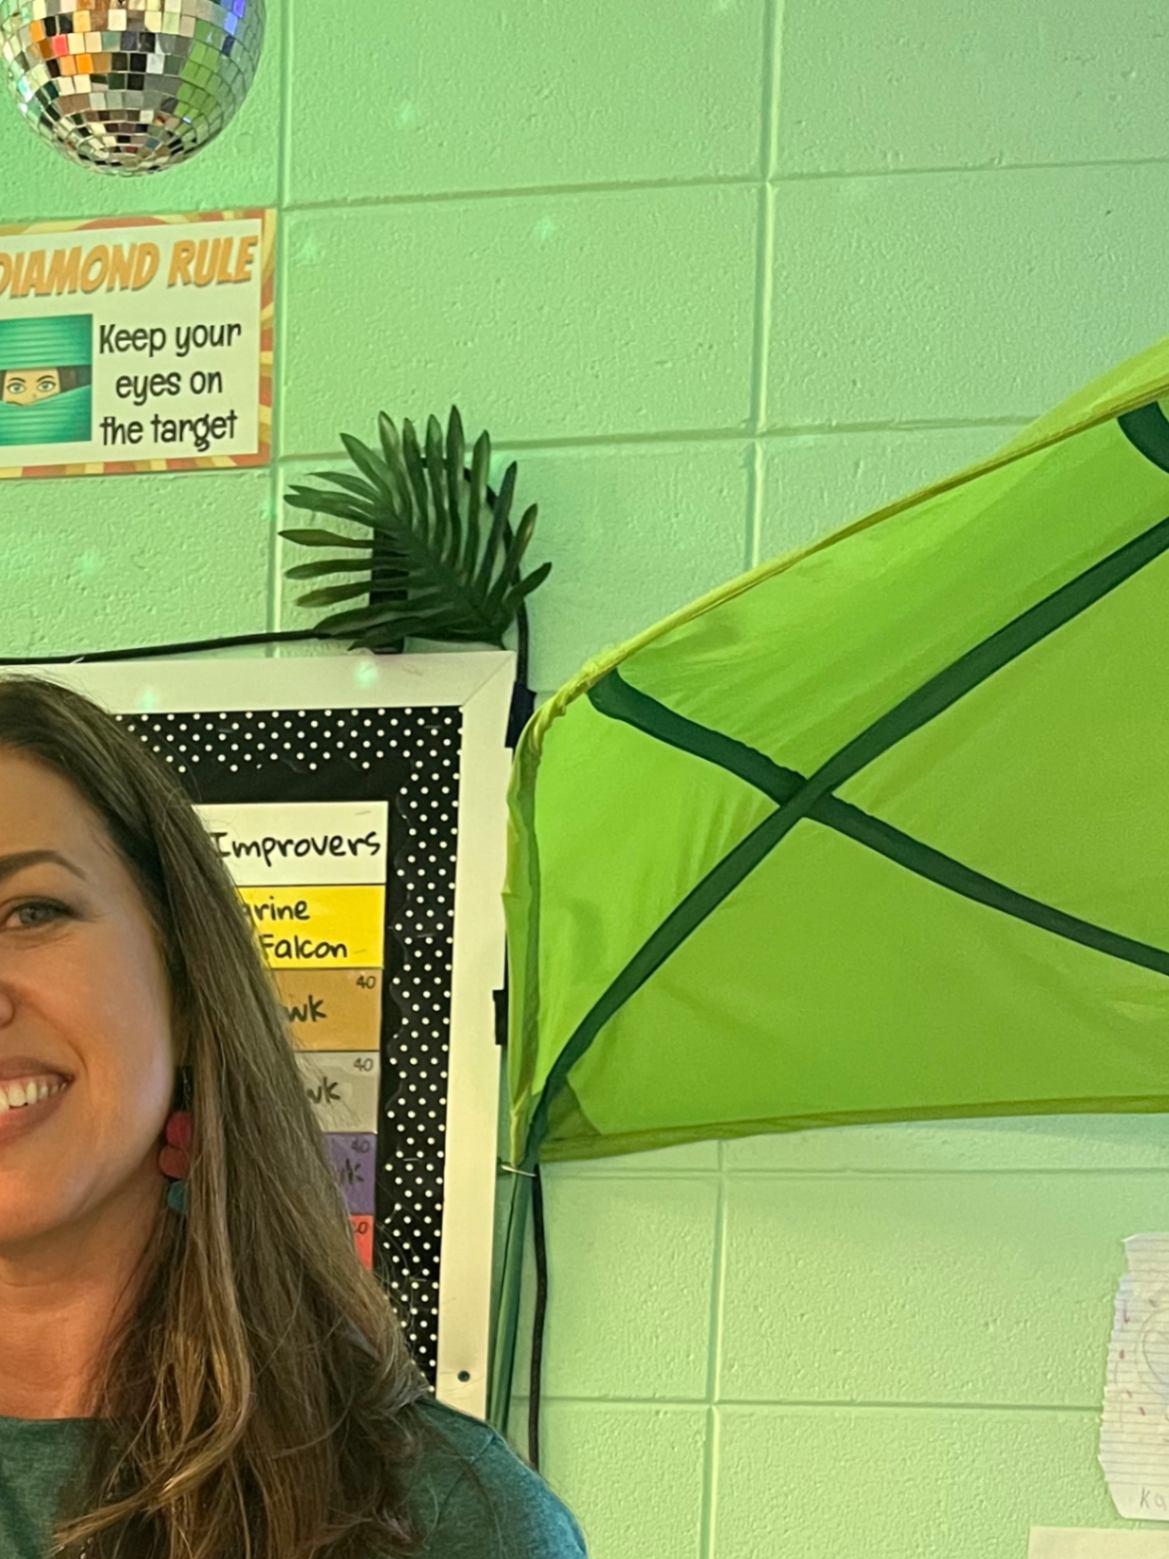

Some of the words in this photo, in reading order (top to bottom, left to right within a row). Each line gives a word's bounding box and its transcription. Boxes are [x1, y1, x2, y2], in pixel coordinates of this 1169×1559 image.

[167, 235, 258, 287] RULE
[99, 323, 167, 357] Keep
[175, 319, 242, 351] your
[115, 371, 181, 404] eyes
[189, 371, 223, 396] on
[99, 413, 143, 446] the
[150, 408, 238, 452] target
[209, 831, 381, 867] Improvers
[259, 934, 348, 960] Falcon
[355, 975, 376, 989] 40
[352, 1057, 373, 1072] 40
